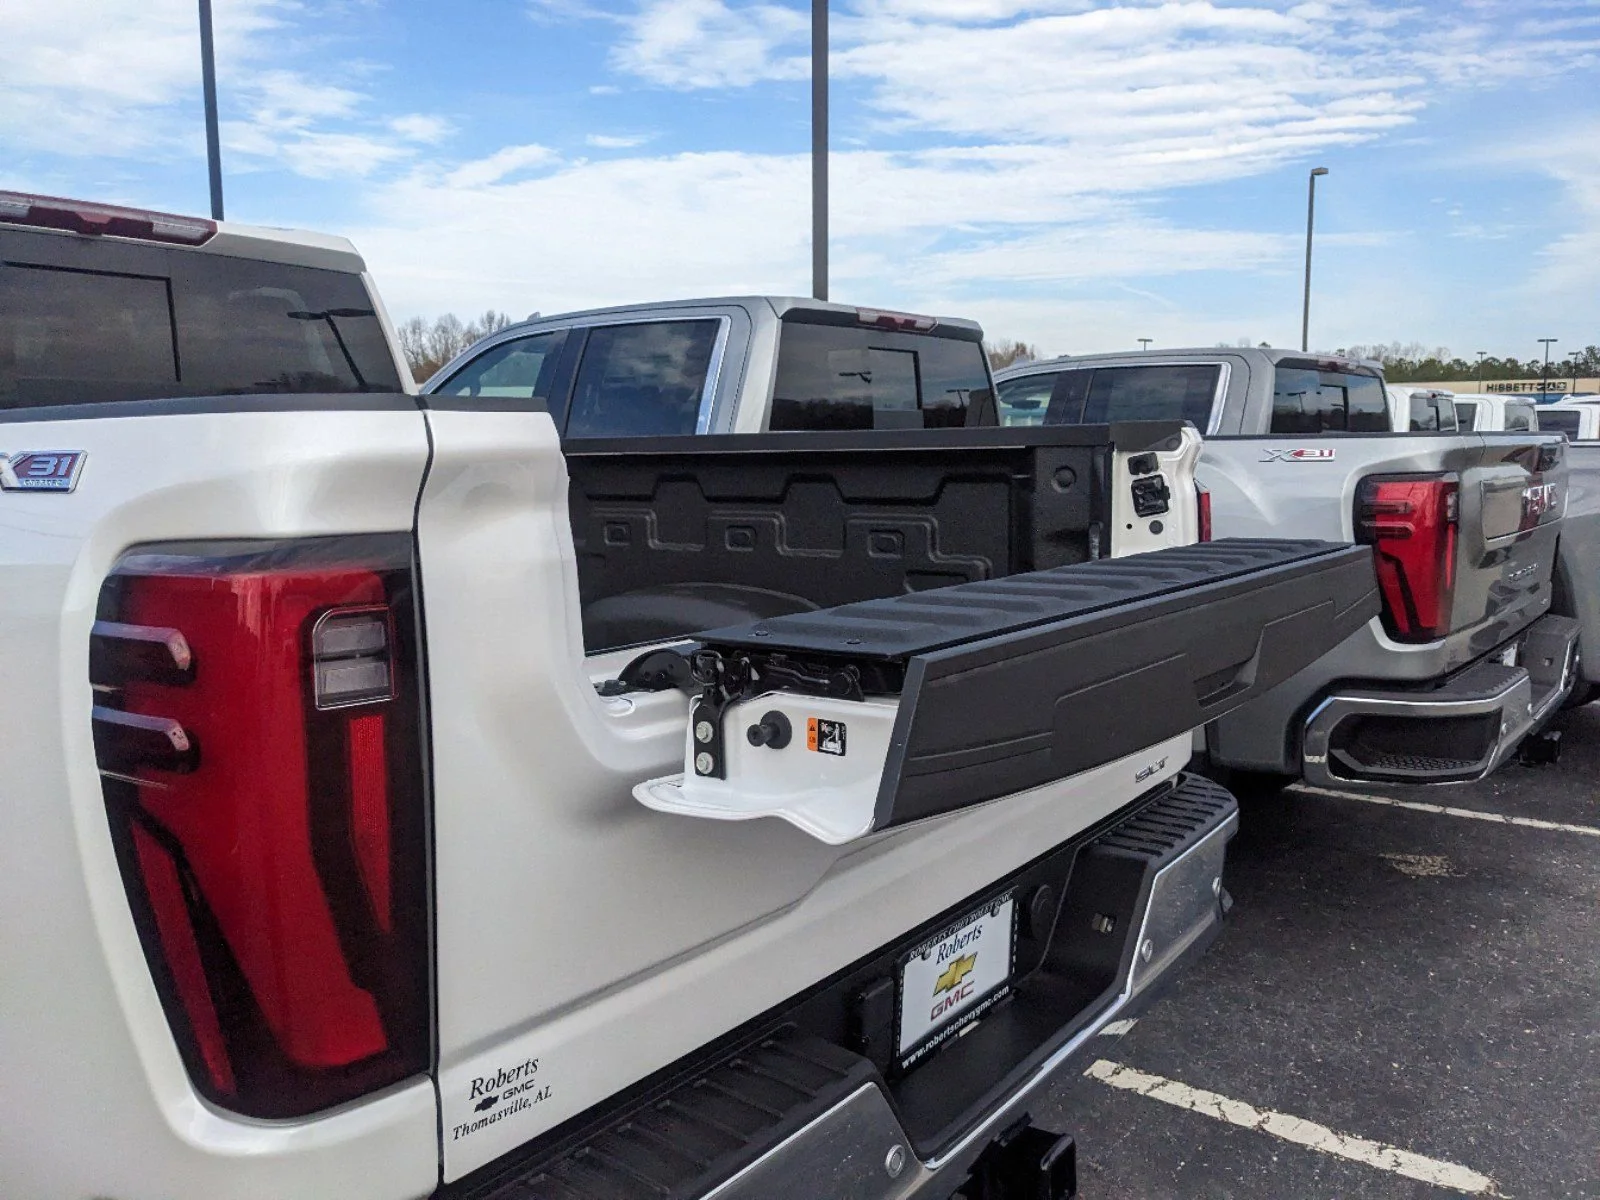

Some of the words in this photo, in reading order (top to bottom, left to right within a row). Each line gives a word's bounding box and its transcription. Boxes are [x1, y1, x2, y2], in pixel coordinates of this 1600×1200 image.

[1486, 382, 1535, 392] HIBBETT
[1135, 755, 1169, 783] SLT
[936, 923, 983, 966] Roberts
[930, 979, 975, 1022] GMC
[901, 985, 1009, 1069] www.robertschevygmc.com
[468, 1058, 539, 1101] Roberts
[502, 1079, 535, 1101] GMC
[453, 1097, 532, 1141] Thomasville,
[534, 1085, 552, 1104] AL
